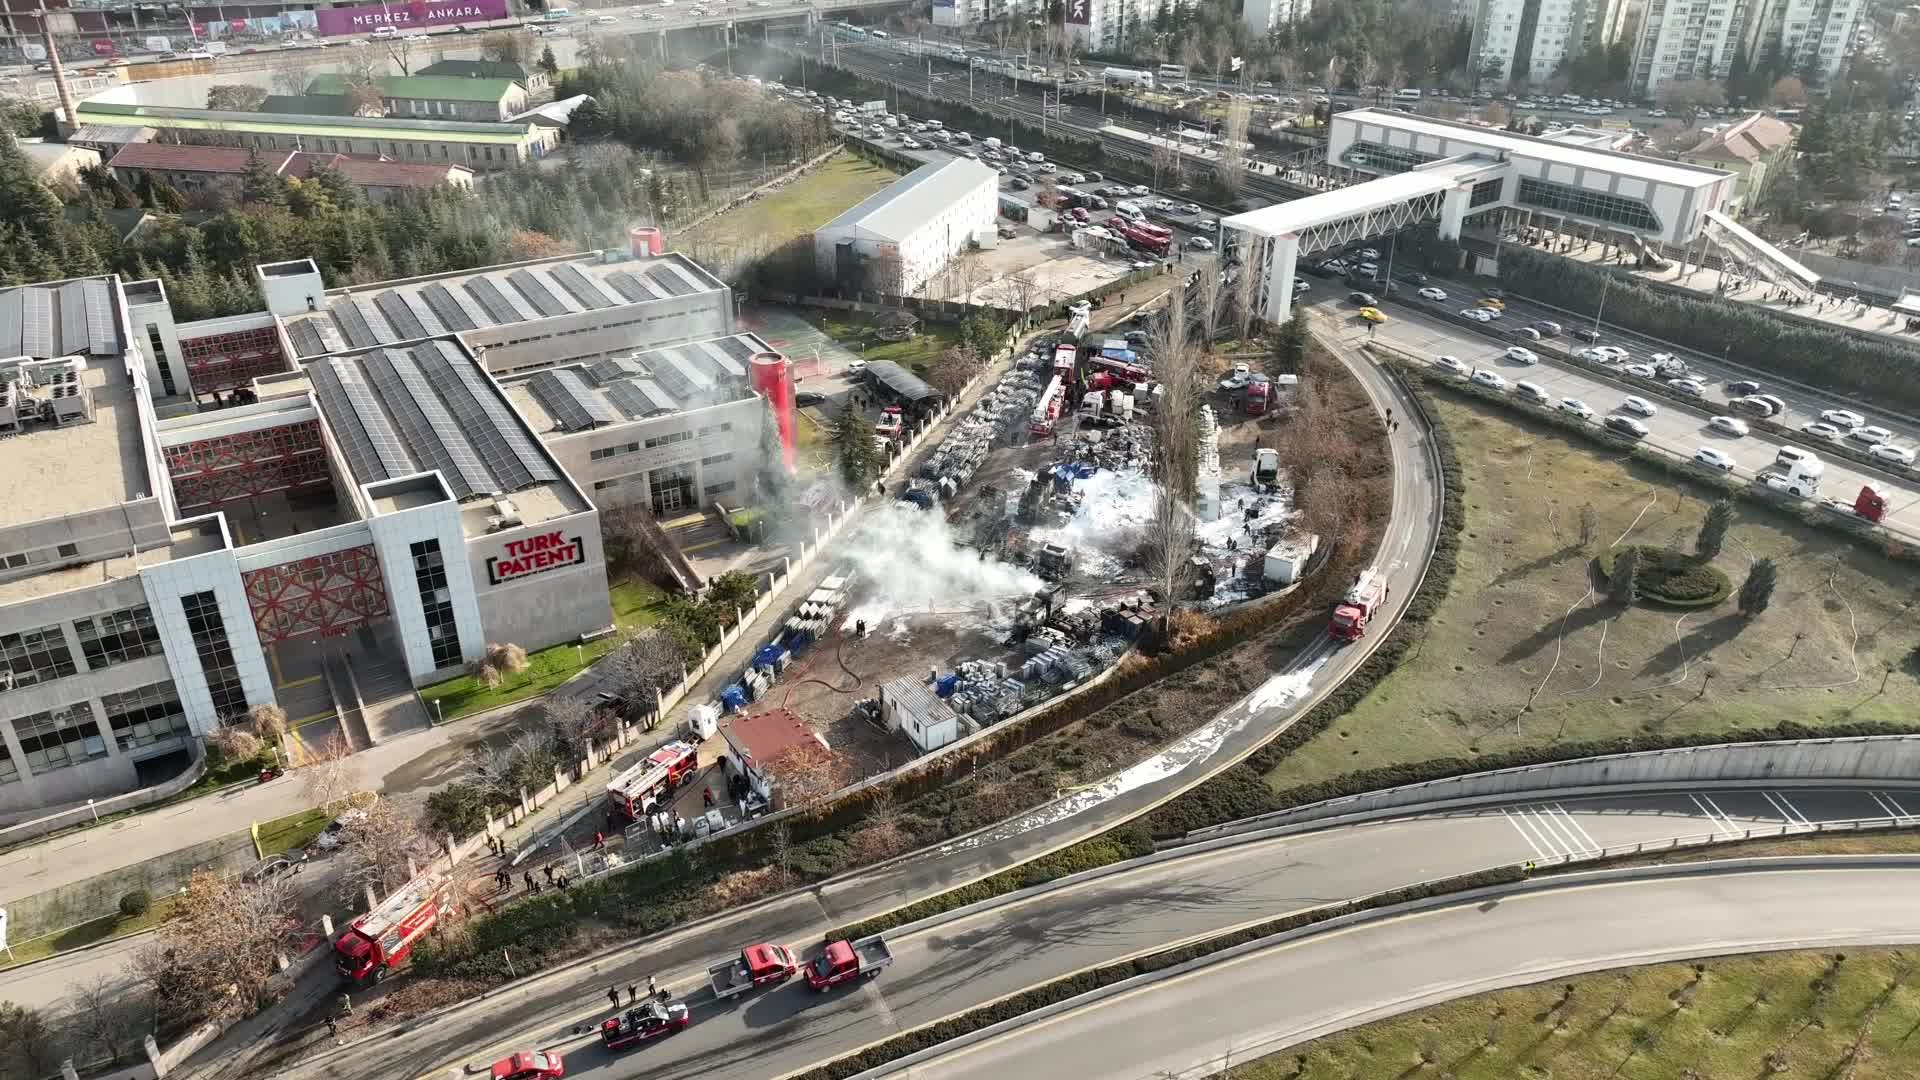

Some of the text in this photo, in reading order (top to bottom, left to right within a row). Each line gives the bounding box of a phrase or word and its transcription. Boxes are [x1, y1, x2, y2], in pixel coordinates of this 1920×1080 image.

[353, 7, 483, 25] MERKEZ ANKARA
[496, 544, 577, 577] PATENT
